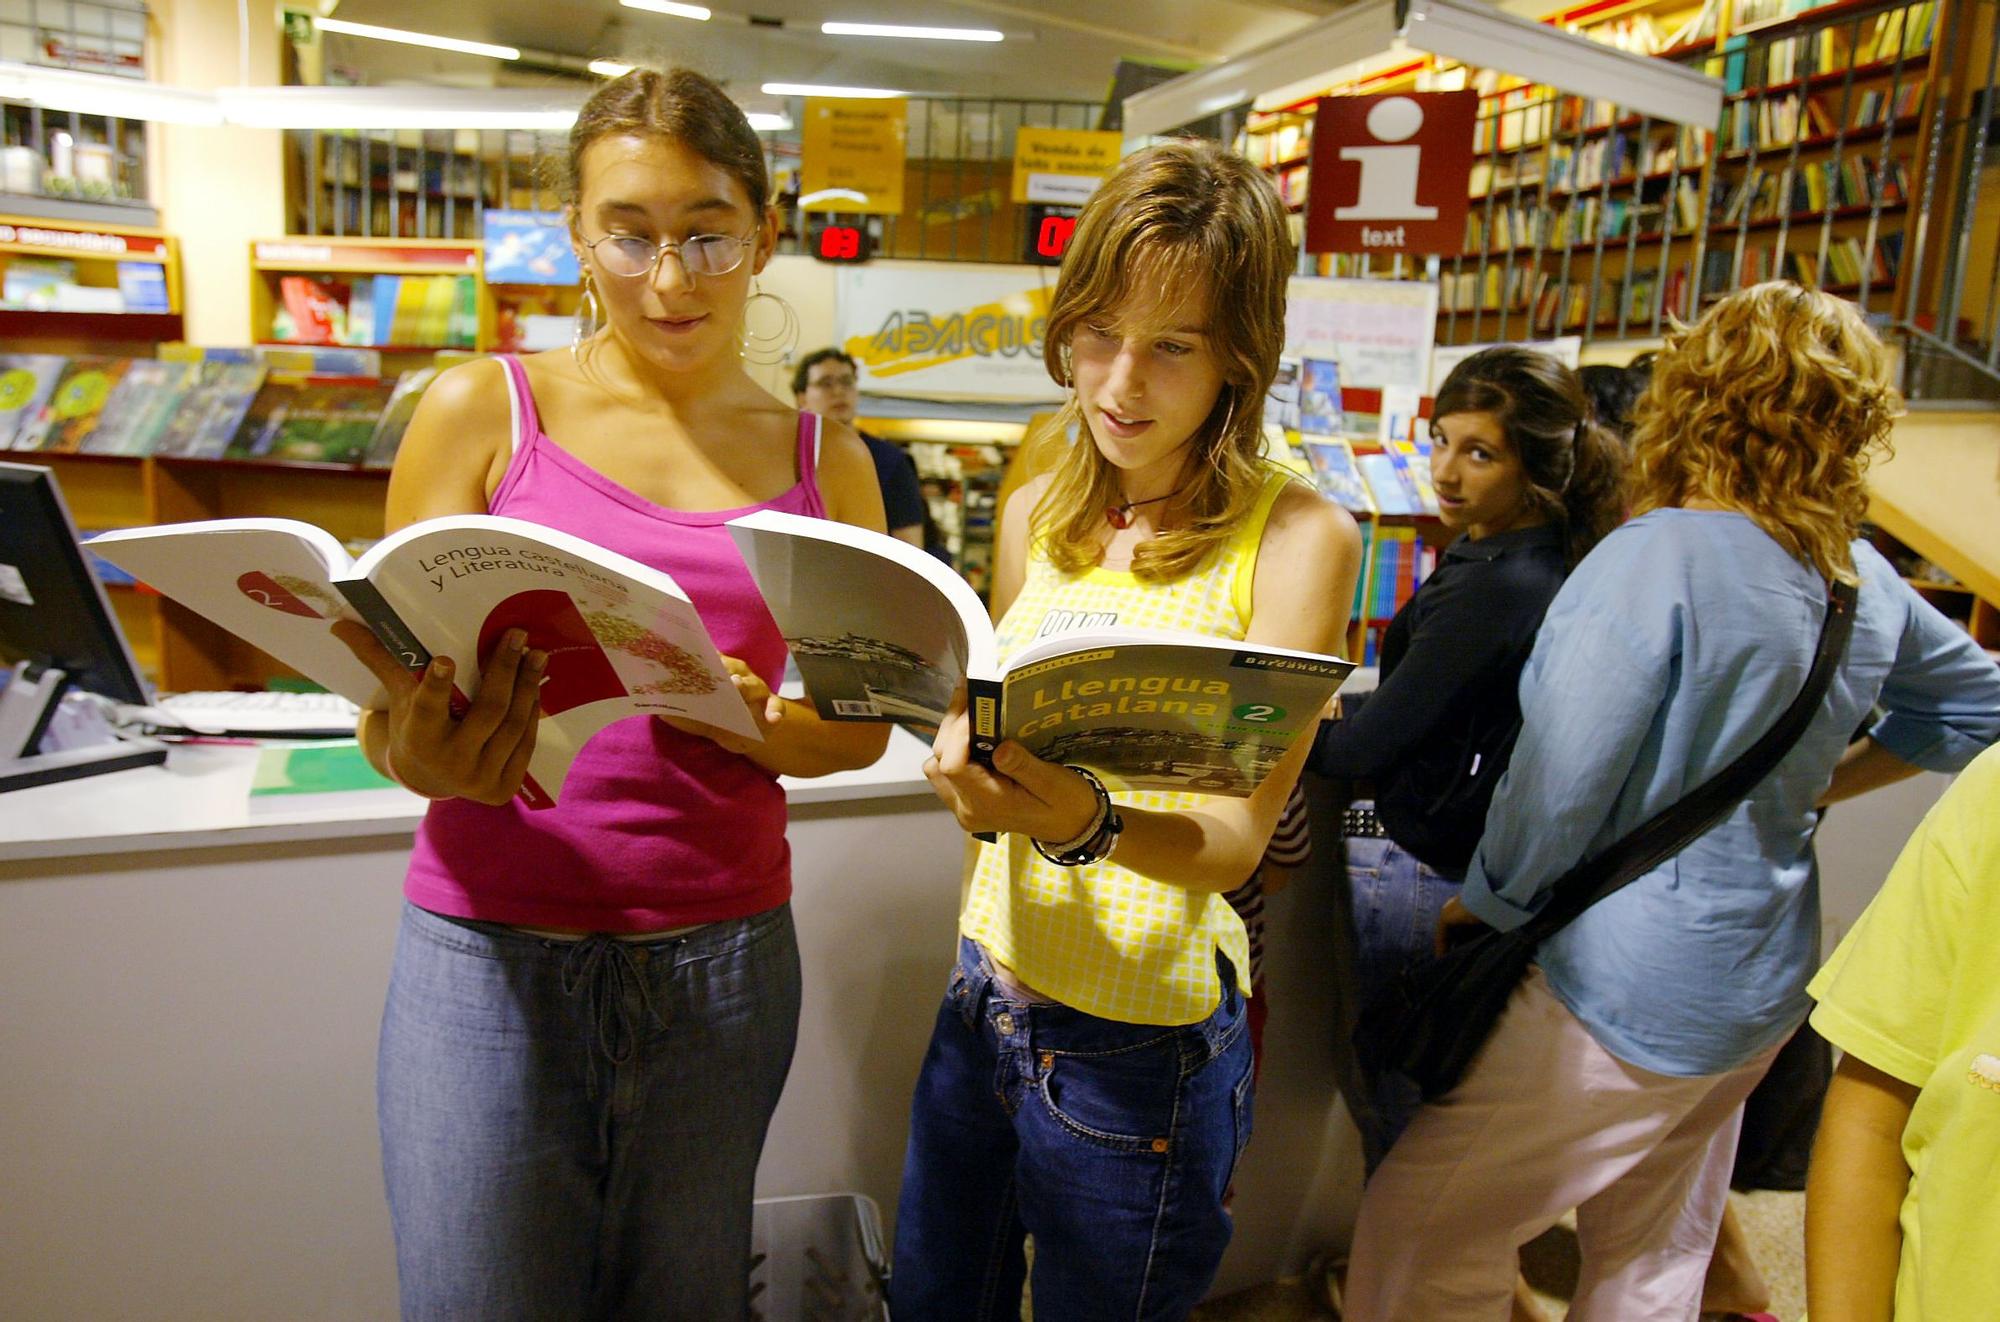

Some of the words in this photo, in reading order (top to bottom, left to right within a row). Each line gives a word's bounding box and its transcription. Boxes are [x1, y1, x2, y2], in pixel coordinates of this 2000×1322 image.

[1362, 225, 1405, 247] text
[418, 545, 512, 573] Lengua
[518, 549, 630, 593] castellana
[430, 575, 444, 593] y
[449, 557, 566, 579] Literatura
[247, 589, 283, 606] 2
[401, 651, 425, 667] 2
[1033, 676, 1230, 710] Llengua
[1017, 696, 1218, 738] catalana
[1243, 705, 1275, 722] 2
